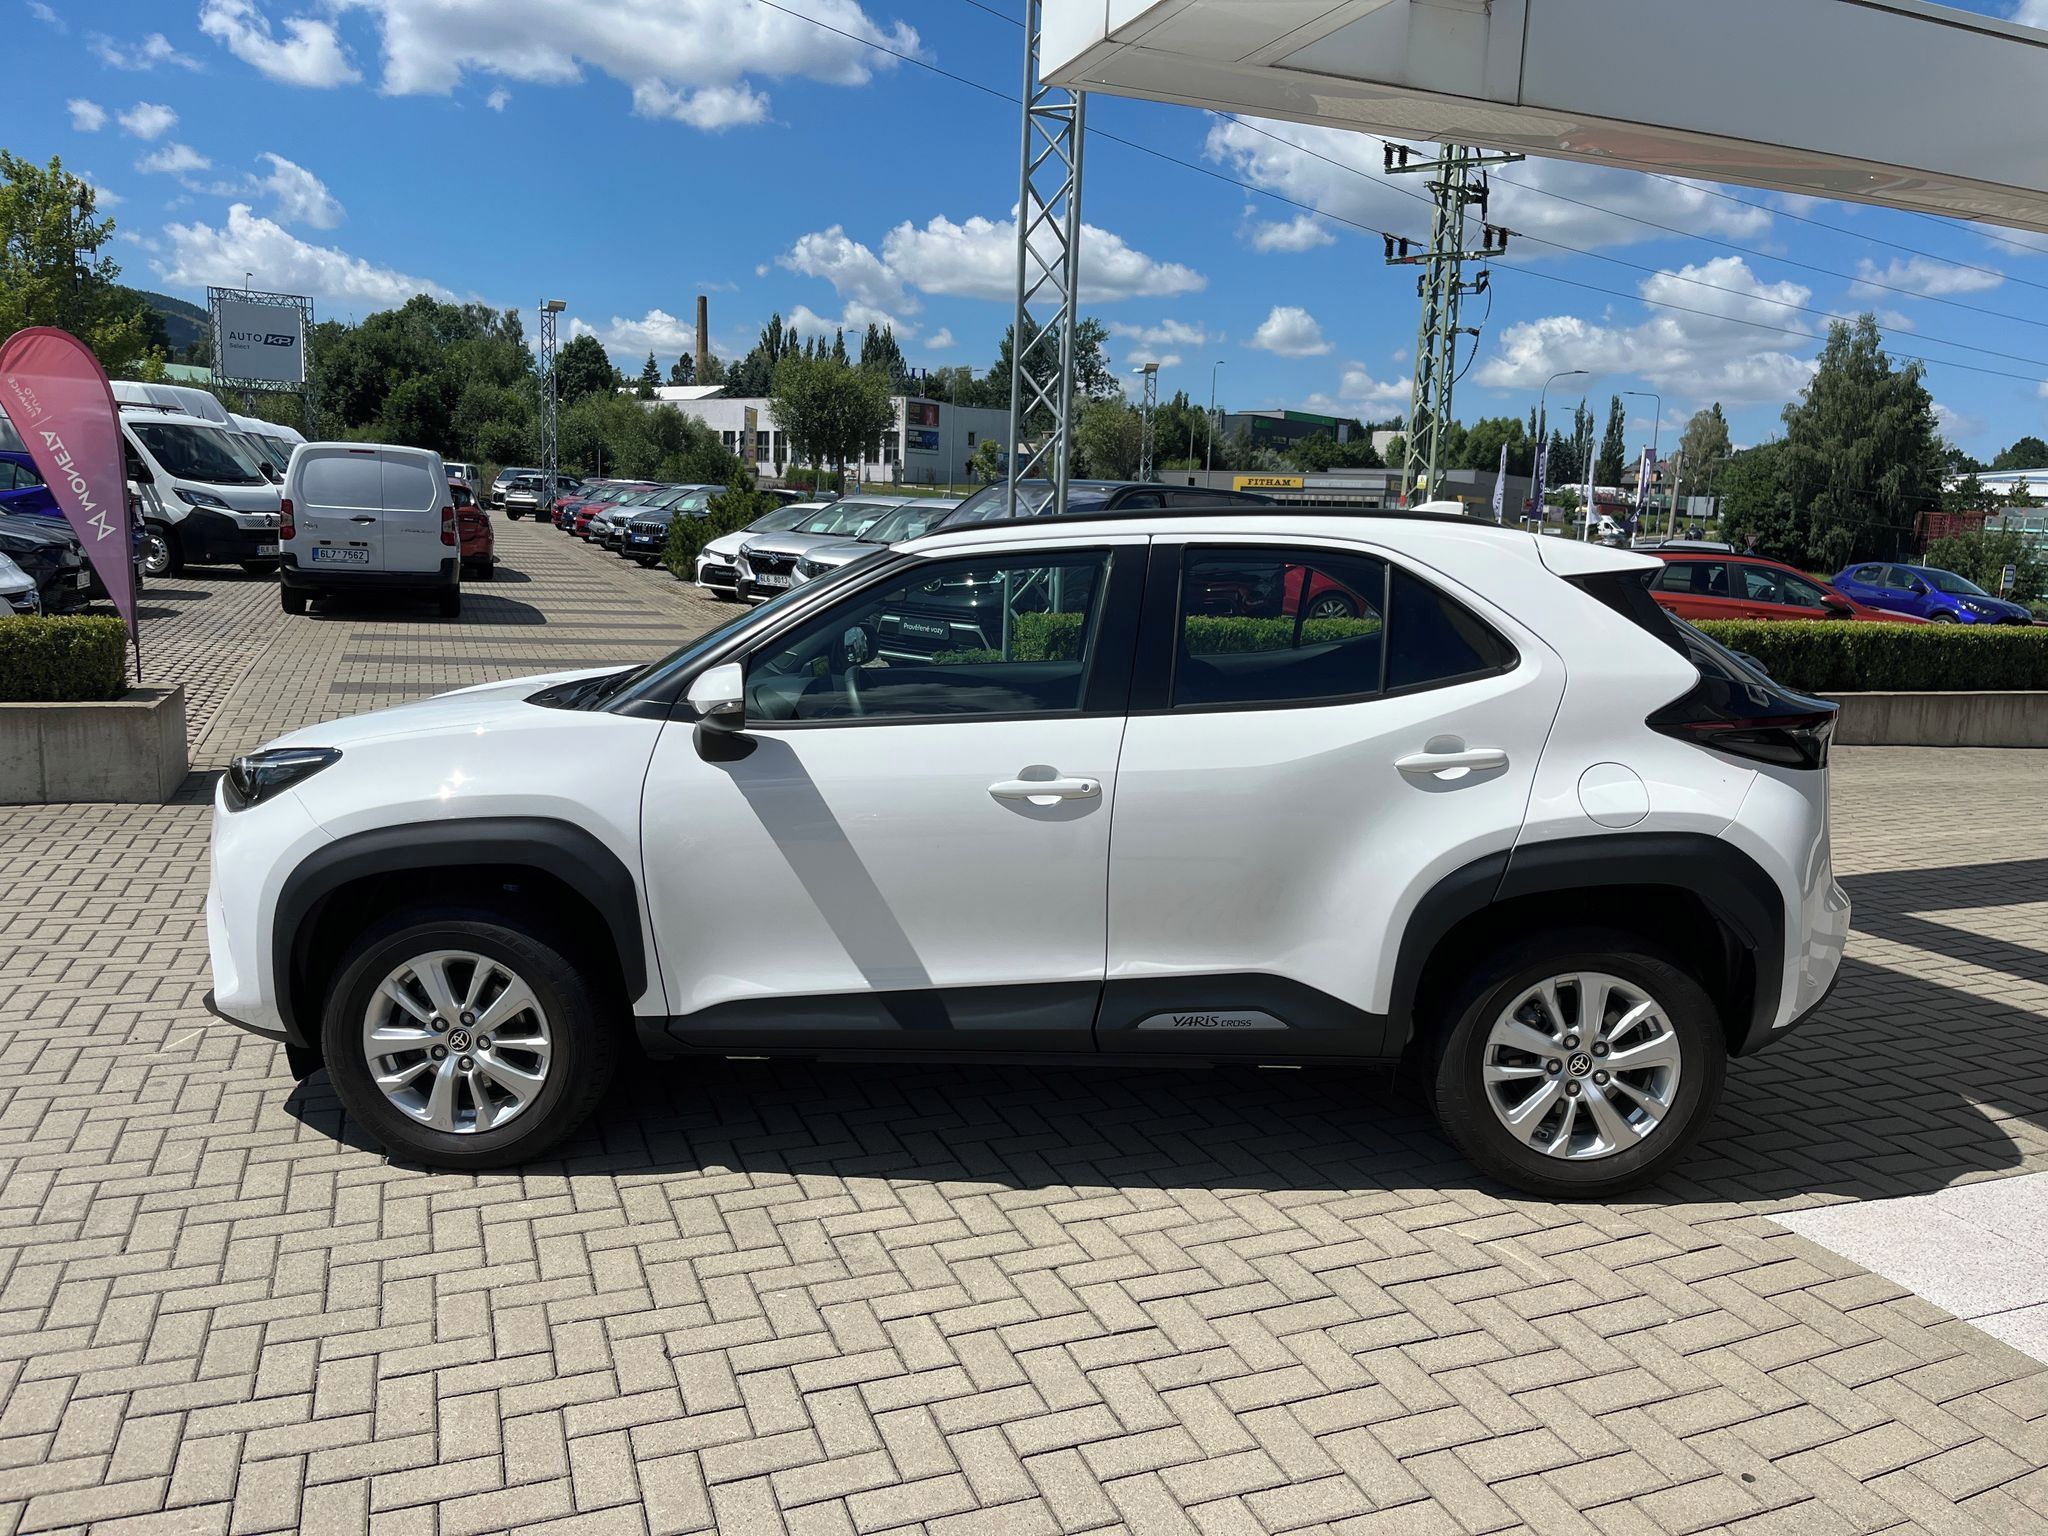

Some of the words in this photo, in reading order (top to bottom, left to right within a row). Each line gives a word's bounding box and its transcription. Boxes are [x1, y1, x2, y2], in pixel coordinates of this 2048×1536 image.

[229, 331, 262, 342] AUTO
[1247, 478, 1291, 486] FITHAM
[320, 549, 336, 559] 6L7
[342, 550, 364, 560] 7562
[930, 627, 944, 635] vozy
[1221, 1019, 1252, 1027] CROSS
